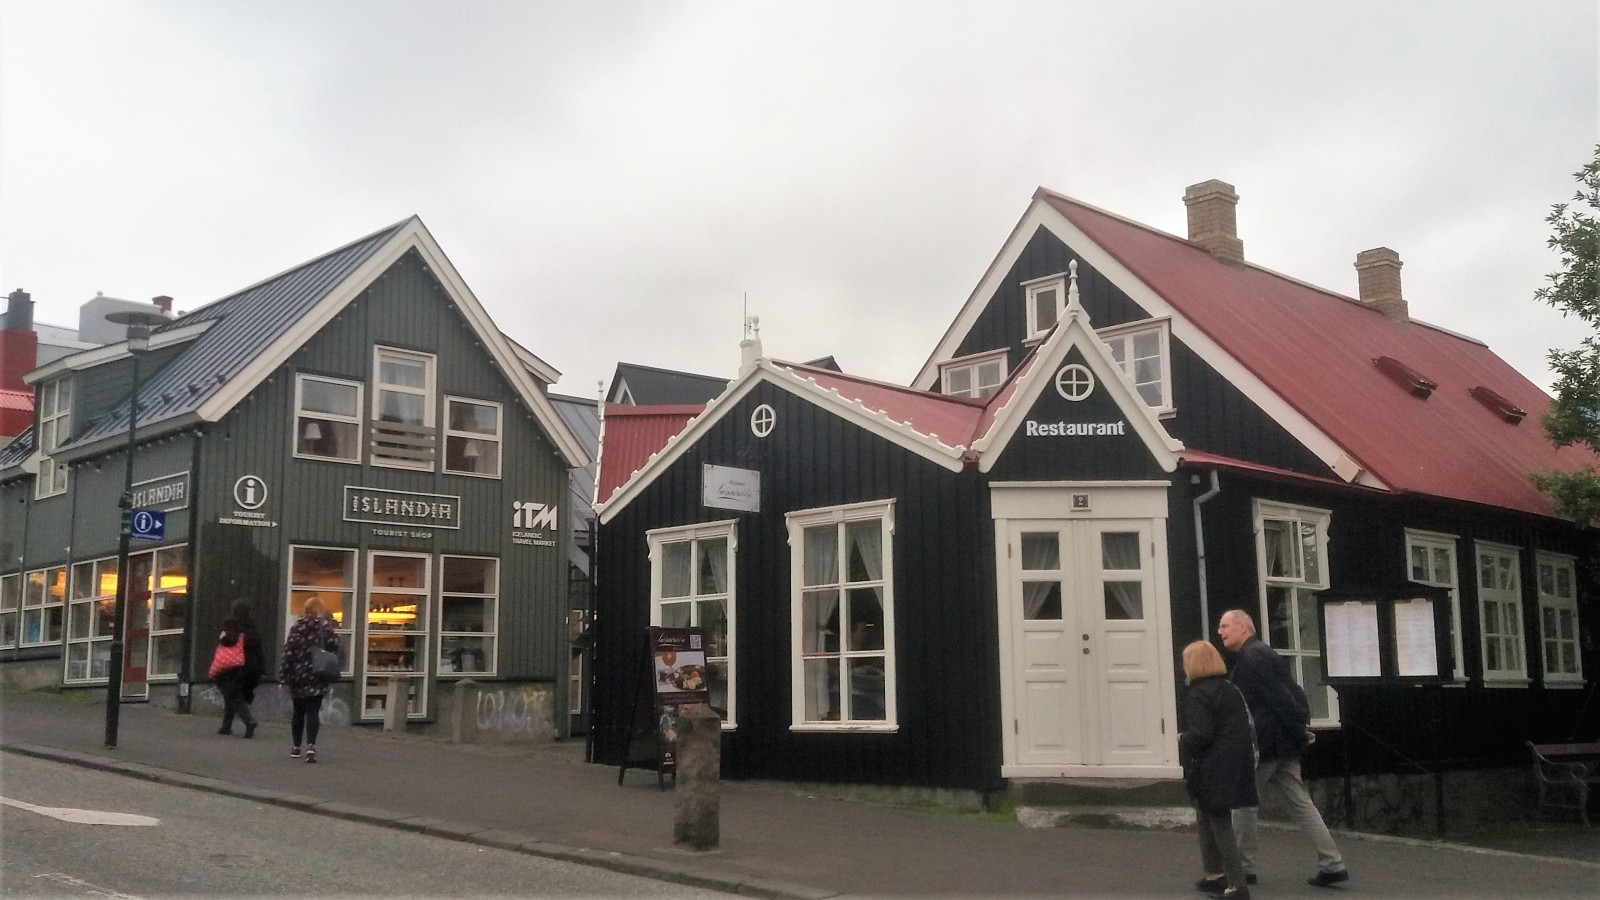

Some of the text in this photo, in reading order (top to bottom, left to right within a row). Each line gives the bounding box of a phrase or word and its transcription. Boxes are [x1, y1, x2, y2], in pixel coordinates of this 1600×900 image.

[1026, 420, 1125, 436] Restaurant
[131, 482, 184, 509] ISLANDIA
[352, 495, 452, 519] ISLANDIA
[218, 518, 271, 527] INFORMATION
[372, 529, 433, 539] TOURIST SHOP
[512, 531, 542, 539] ICELANDIC
